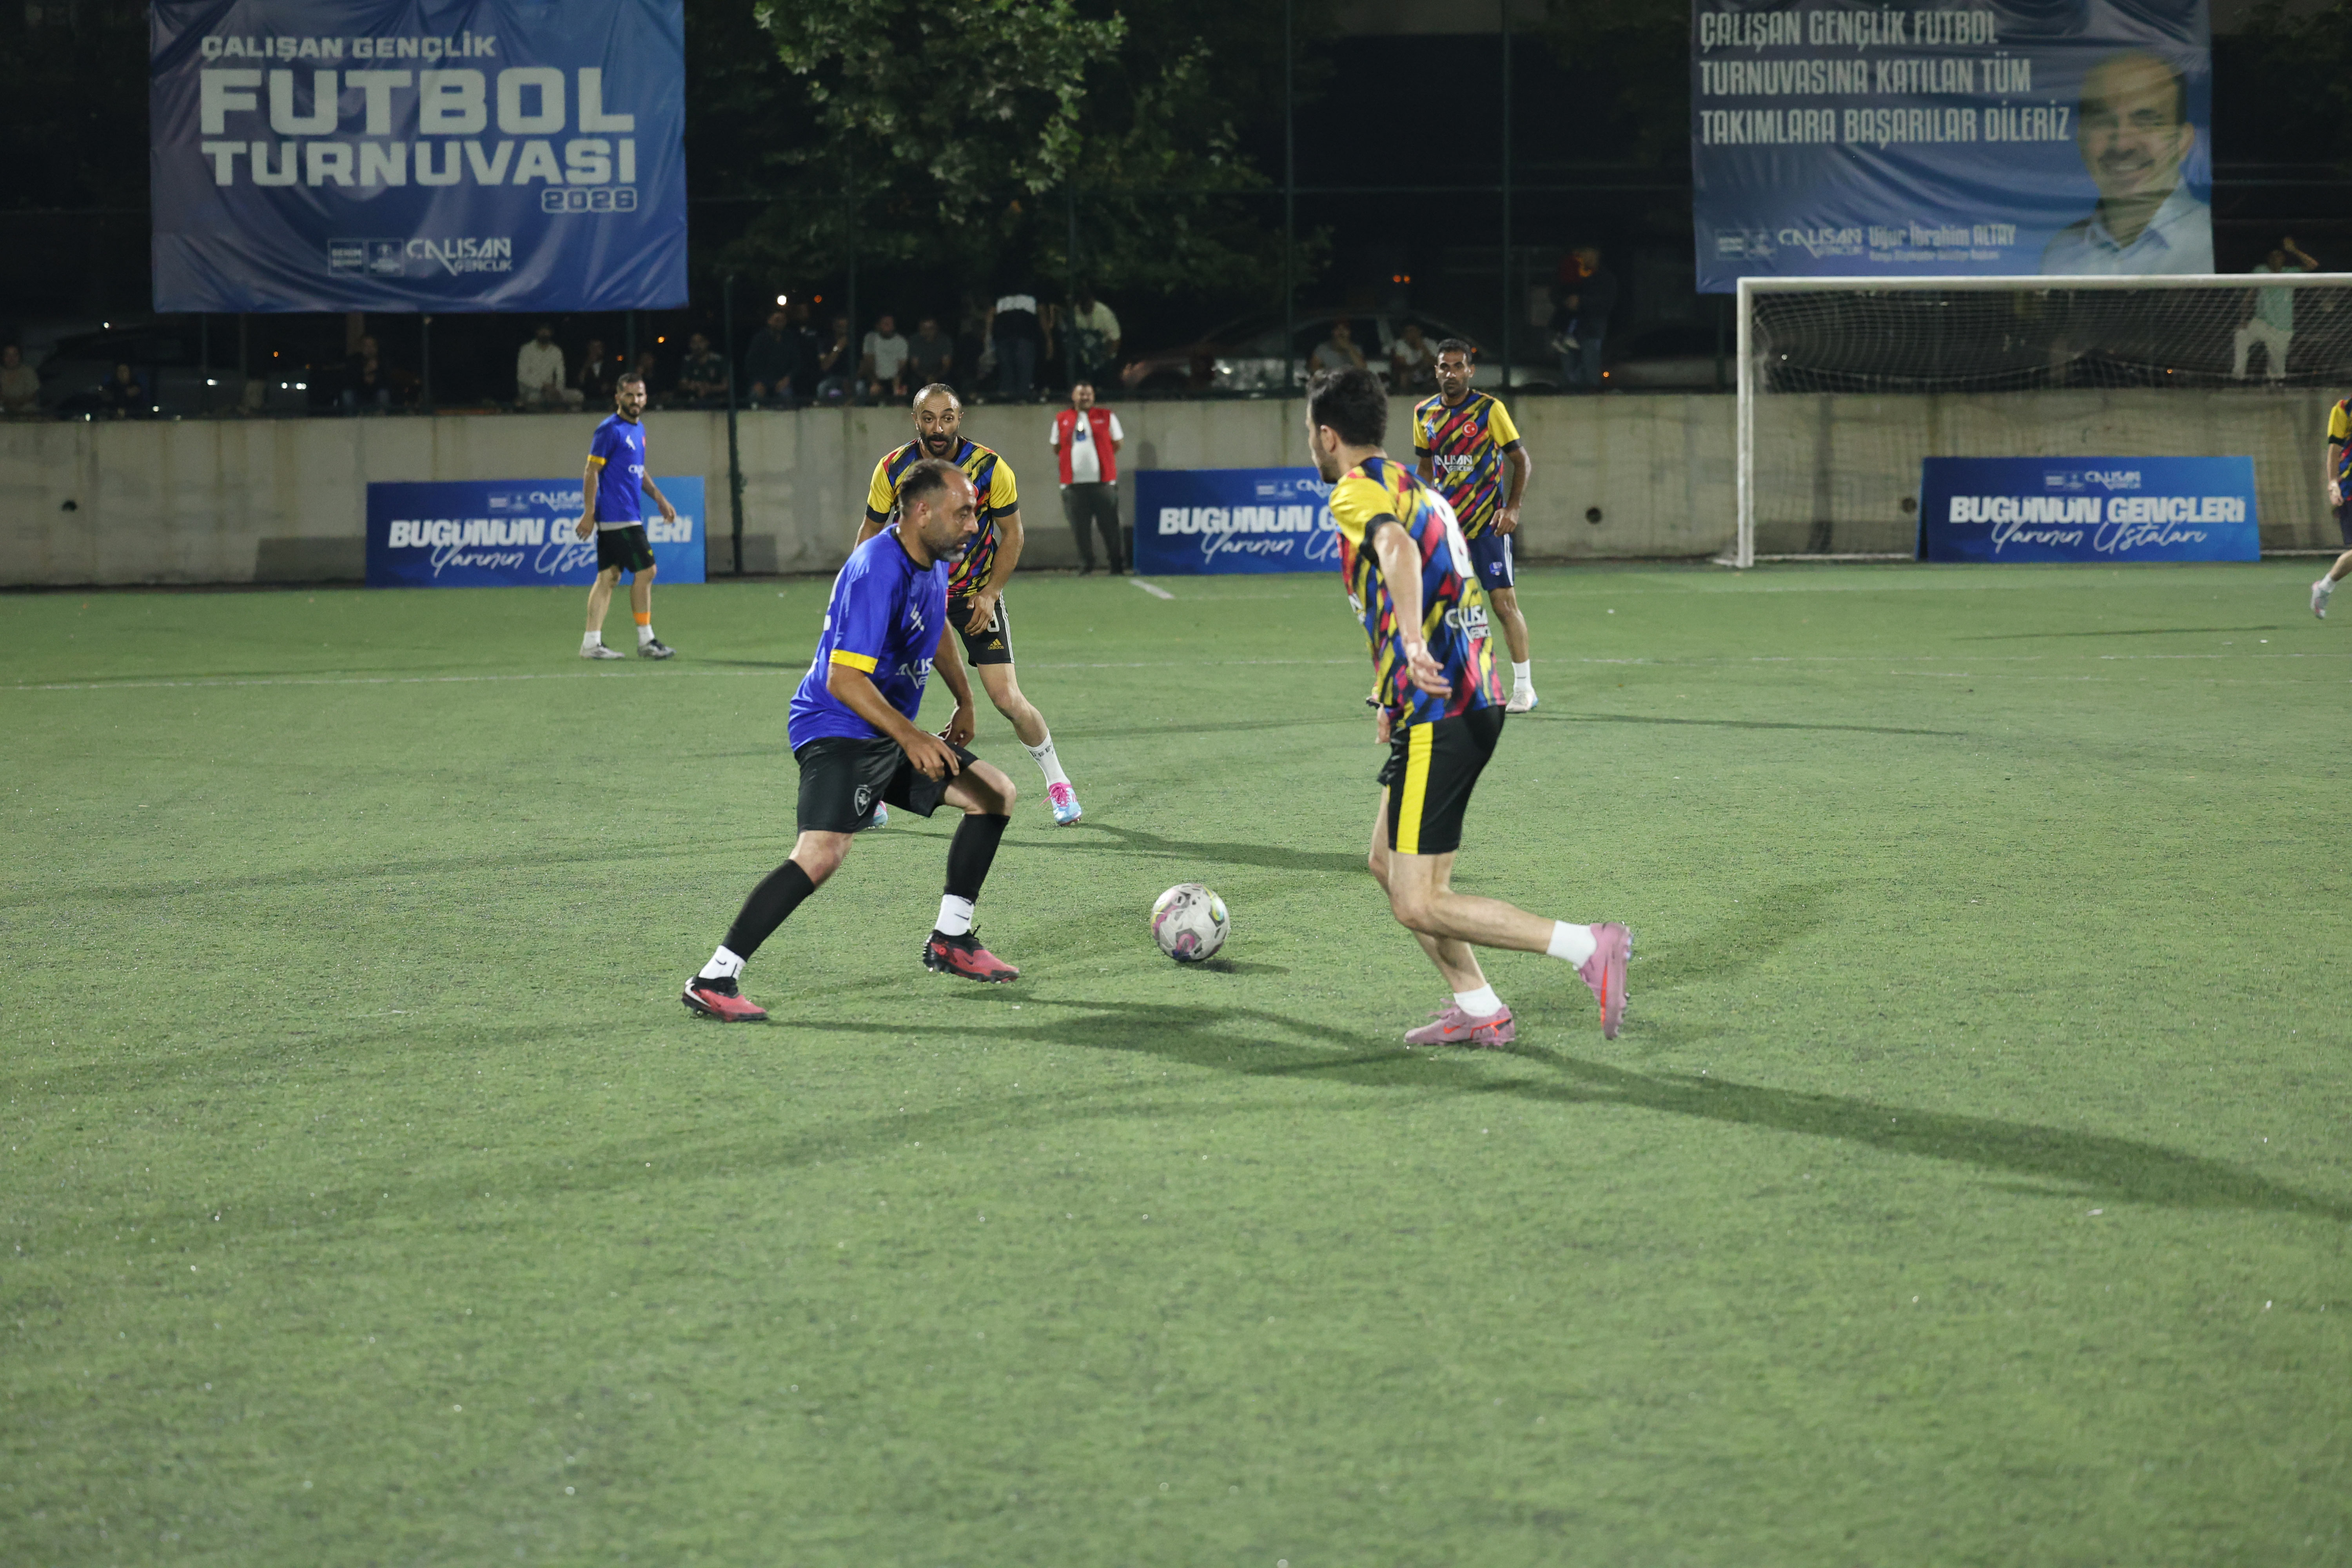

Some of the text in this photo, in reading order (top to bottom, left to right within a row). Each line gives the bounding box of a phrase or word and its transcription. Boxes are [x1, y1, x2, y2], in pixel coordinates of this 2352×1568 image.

[201, 31, 497, 62] ÇALIŞAN GENÇLİK
[1700, 3, 1998, 53] ÇALIŞAN GENÇLİK FUTBOL
[1700, 51, 2031, 95] TURNUVASINA KATILAN TÜM
[200, 67, 635, 135] FUTBOL
[1700, 99, 2071, 151] TAKIMLARA BAŞARILAR DİLERİZ
[201, 138, 636, 187] TURNUVASI
